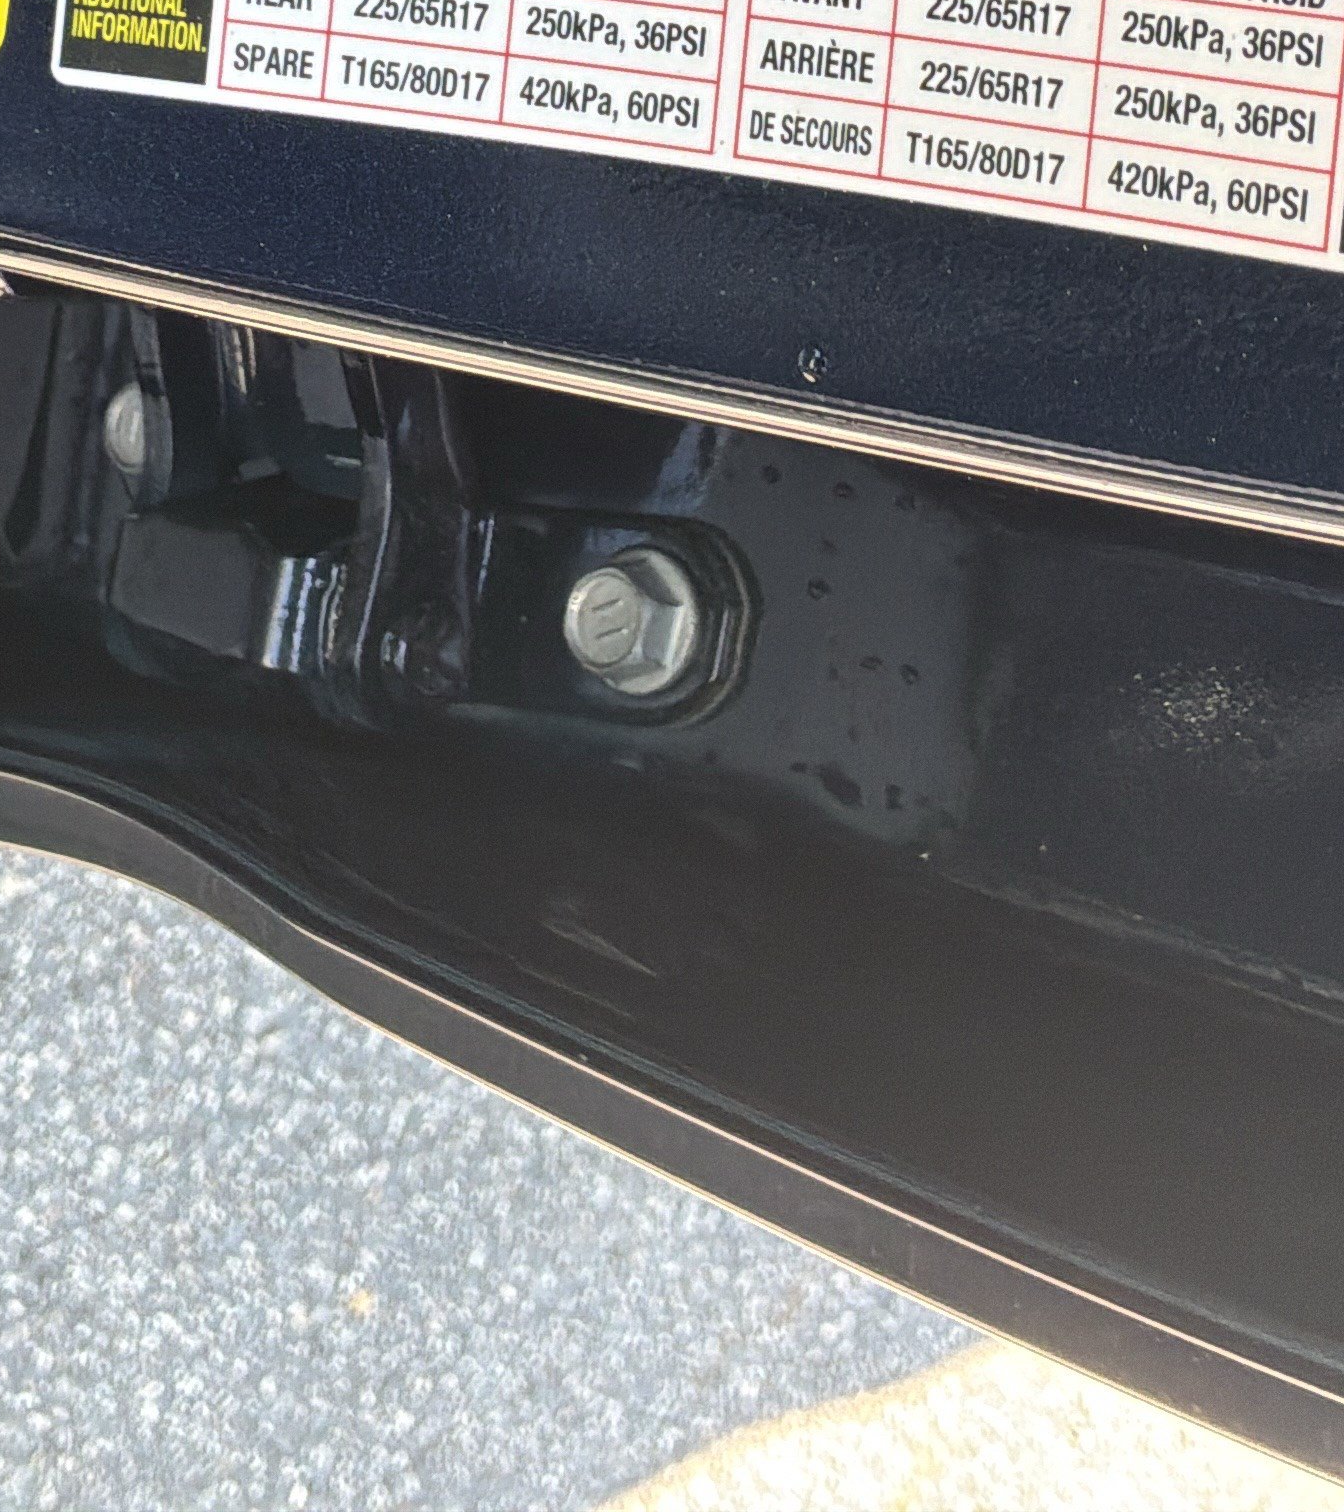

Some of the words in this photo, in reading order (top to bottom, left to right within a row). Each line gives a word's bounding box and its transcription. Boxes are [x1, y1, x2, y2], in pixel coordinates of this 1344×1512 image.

[71, 8, 207, 53] INFORMATION.
[525, 6, 626, 53] 250kPa,
[634, 19, 707, 58] 36PSI
[1121, 10, 1232, 63] 250kPa,
[1241, 26, 1324, 68] 36PSI
[233, 42, 315, 80] SPARE
[341, 54, 490, 102] T165/80D17
[759, 38, 875, 84] ARRIÈRE
[919, 60, 1064, 110] 225/65R17
[519, 76, 619, 124] 420kPa,
[627, 90, 700, 129] 60PSI
[1114, 84, 1224, 138] 250kPa,
[1234, 101, 1316, 145] 36PSI
[749, 109, 776, 142] DE
[780, 114, 873, 156] SECOURS
[906, 131, 1065, 185] T165/80D17
[1107, 160, 1217, 214] 420kPa,
[1227, 178, 1309, 223] 60PSI
